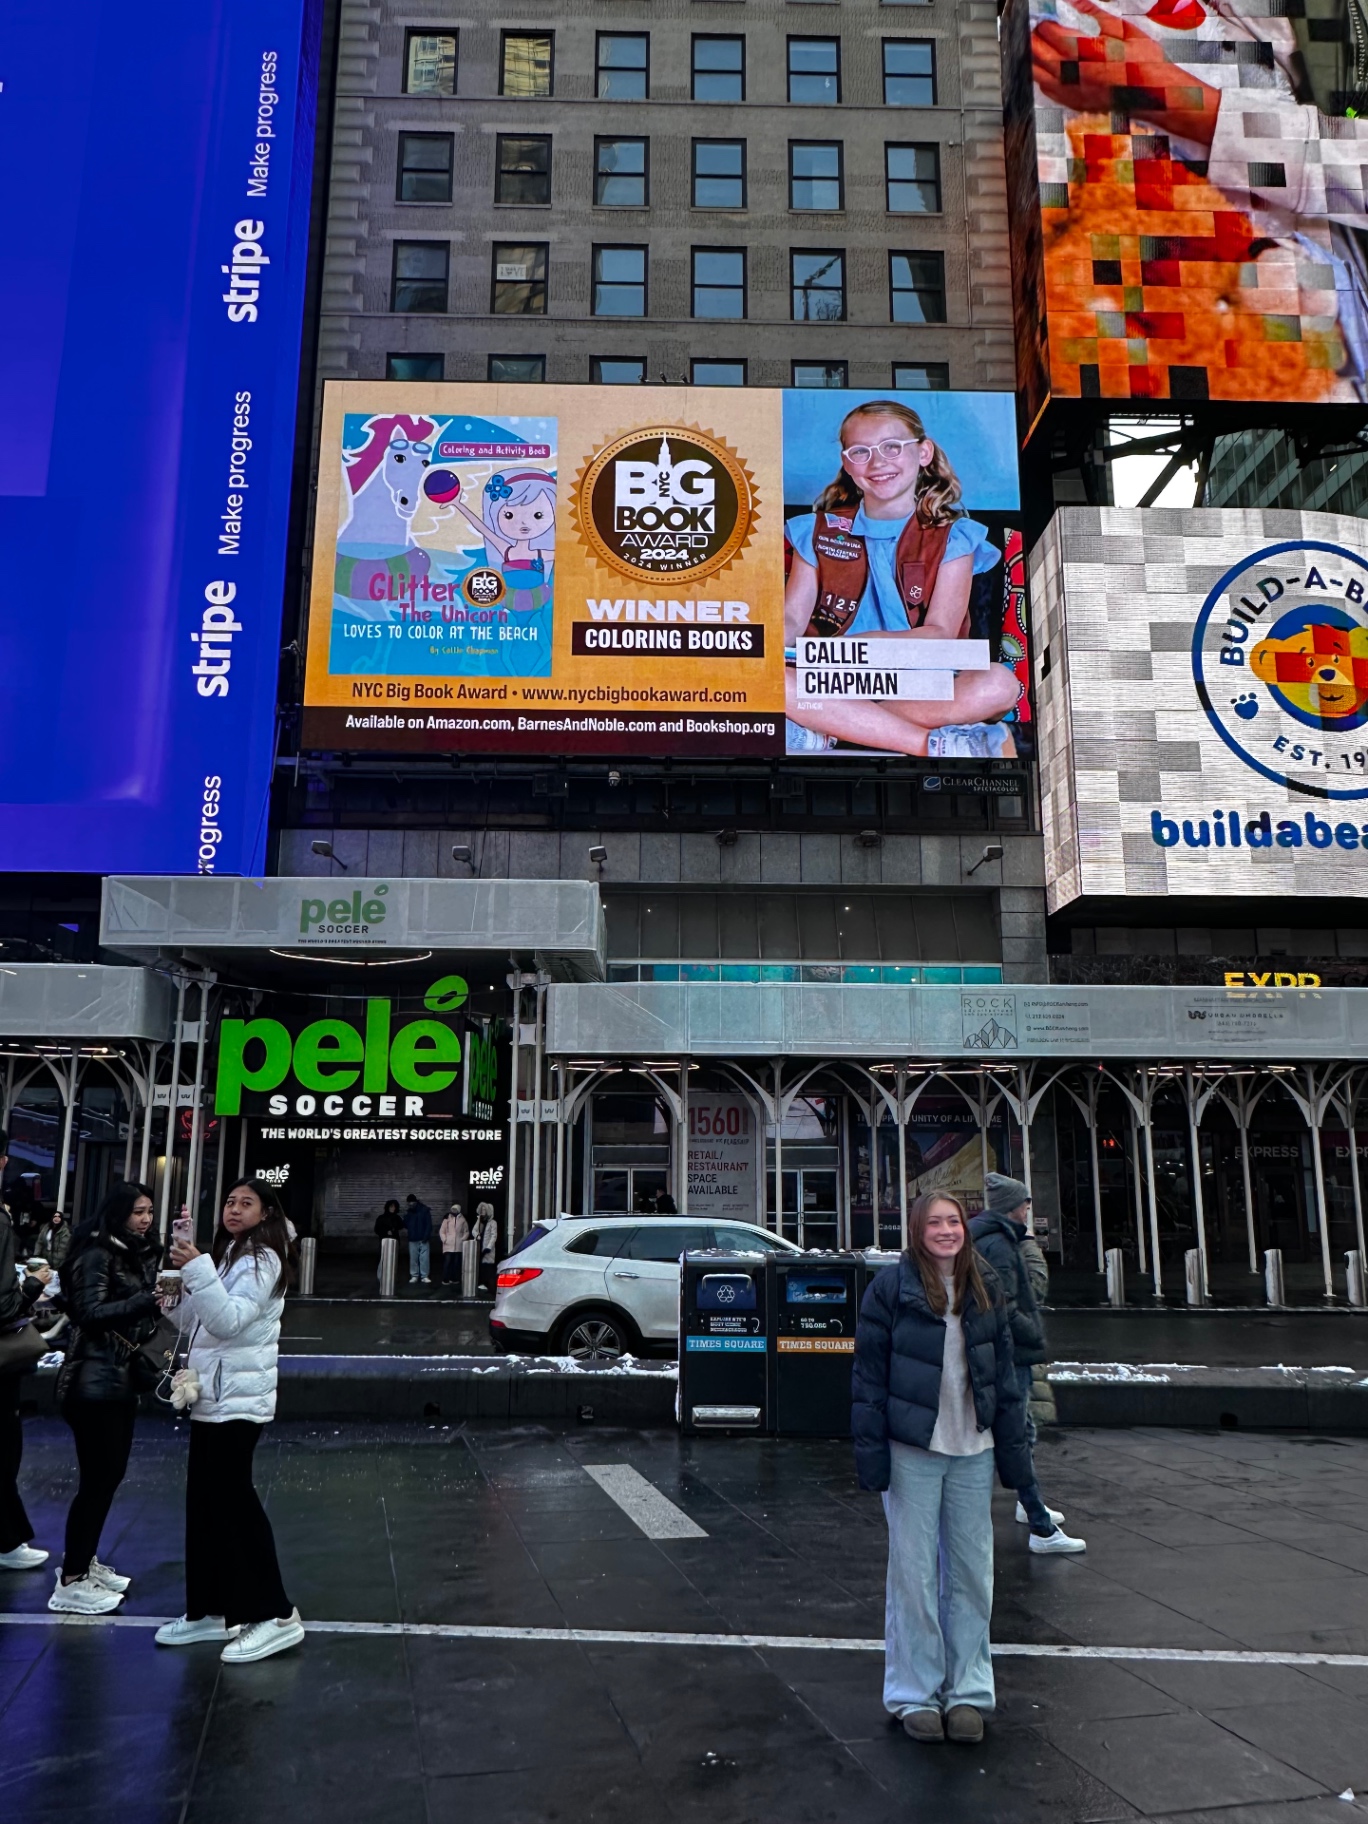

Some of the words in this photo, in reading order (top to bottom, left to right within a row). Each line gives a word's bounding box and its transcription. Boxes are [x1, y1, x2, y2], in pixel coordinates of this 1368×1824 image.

[257, 51, 279, 138] progress
[247, 142, 271, 197] Make
[221, 219, 271, 323] stripe
[228, 391, 253, 489] progress
[442, 446, 475, 456] Coloring
[479, 446, 493, 455] and
[496, 446, 526, 457] Activity
[528, 446, 546, 455] Book
[659, 471, 670, 497] NYC
[218, 494, 243, 556] Make
[617, 506, 713, 531] BOOK
[620, 534, 708, 548] AWARD
[623, 553, 652, 569] 2024
[660, 553, 707, 571] WINNER
[640, 549, 689, 560] 2024
[399, 603, 432, 623] The
[441, 603, 508, 623] Unicorn
[586, 599, 750, 621] WINNER
[190, 580, 243, 698] stripe
[343, 624, 381, 638] LOVES
[388, 625, 402, 638] TO
[408, 625, 443, 639] COLOR
[450, 626, 465, 639] AT
[471, 626, 493, 640] THE
[499, 627, 538, 641] BEACH
[585, 628, 681, 649] COLORING
[688, 630, 752, 650] BOOKS
[804, 641, 868, 664] CALLIE
[352, 682, 382, 698] NYC
[386, 683, 410, 701] Big
[414, 684, 453, 699] Book
[457, 684, 507, 700] Award
[522, 686, 747, 704] www.nycbigbookaward.com
[804, 671, 898, 695] CHAPMAN
[345, 714, 405, 730] Available
[408, 718, 424, 729] on
[426, 716, 515, 732] Amazon.com,
[517, 717, 657, 732] BarnesAndNoble.com
[659, 718, 684, 732] and
[686, 719, 775, 735] Bookshop.org
[1273, 735, 1330, 769] EST.
[197, 775, 223, 874] rogress
[318, 925, 369, 934] SOCCER
[963, 998, 1012, 1008] ROCK
[214, 975, 468, 1116] pelé
[268, 1095, 424, 1117] SOCCER
[688, 1107, 740, 1135] 1560
[940, 1115, 952, 1123] OF
[954, 1115, 962, 1123] A
[261, 1128, 285, 1139] THE
[288, 1128, 341, 1140] WORLD'S
[343, 1128, 408, 1140] GREATEST
[410, 1129, 460, 1141] SOCCER
[461, 1130, 502, 1141] STORE
[469, 1165, 504, 1184] pelé
[688, 1162, 749, 1172] RESTAURANT
[688, 1173, 717, 1183] SPACE
[688, 1185, 738, 1195] AVAILABLE
[689, 1339, 721, 1348] TIMES
[725, 1339, 764, 1349] SQUARE
[780, 1341, 812, 1349] TIMES
[815, 1341, 854, 1350] SQUARE
